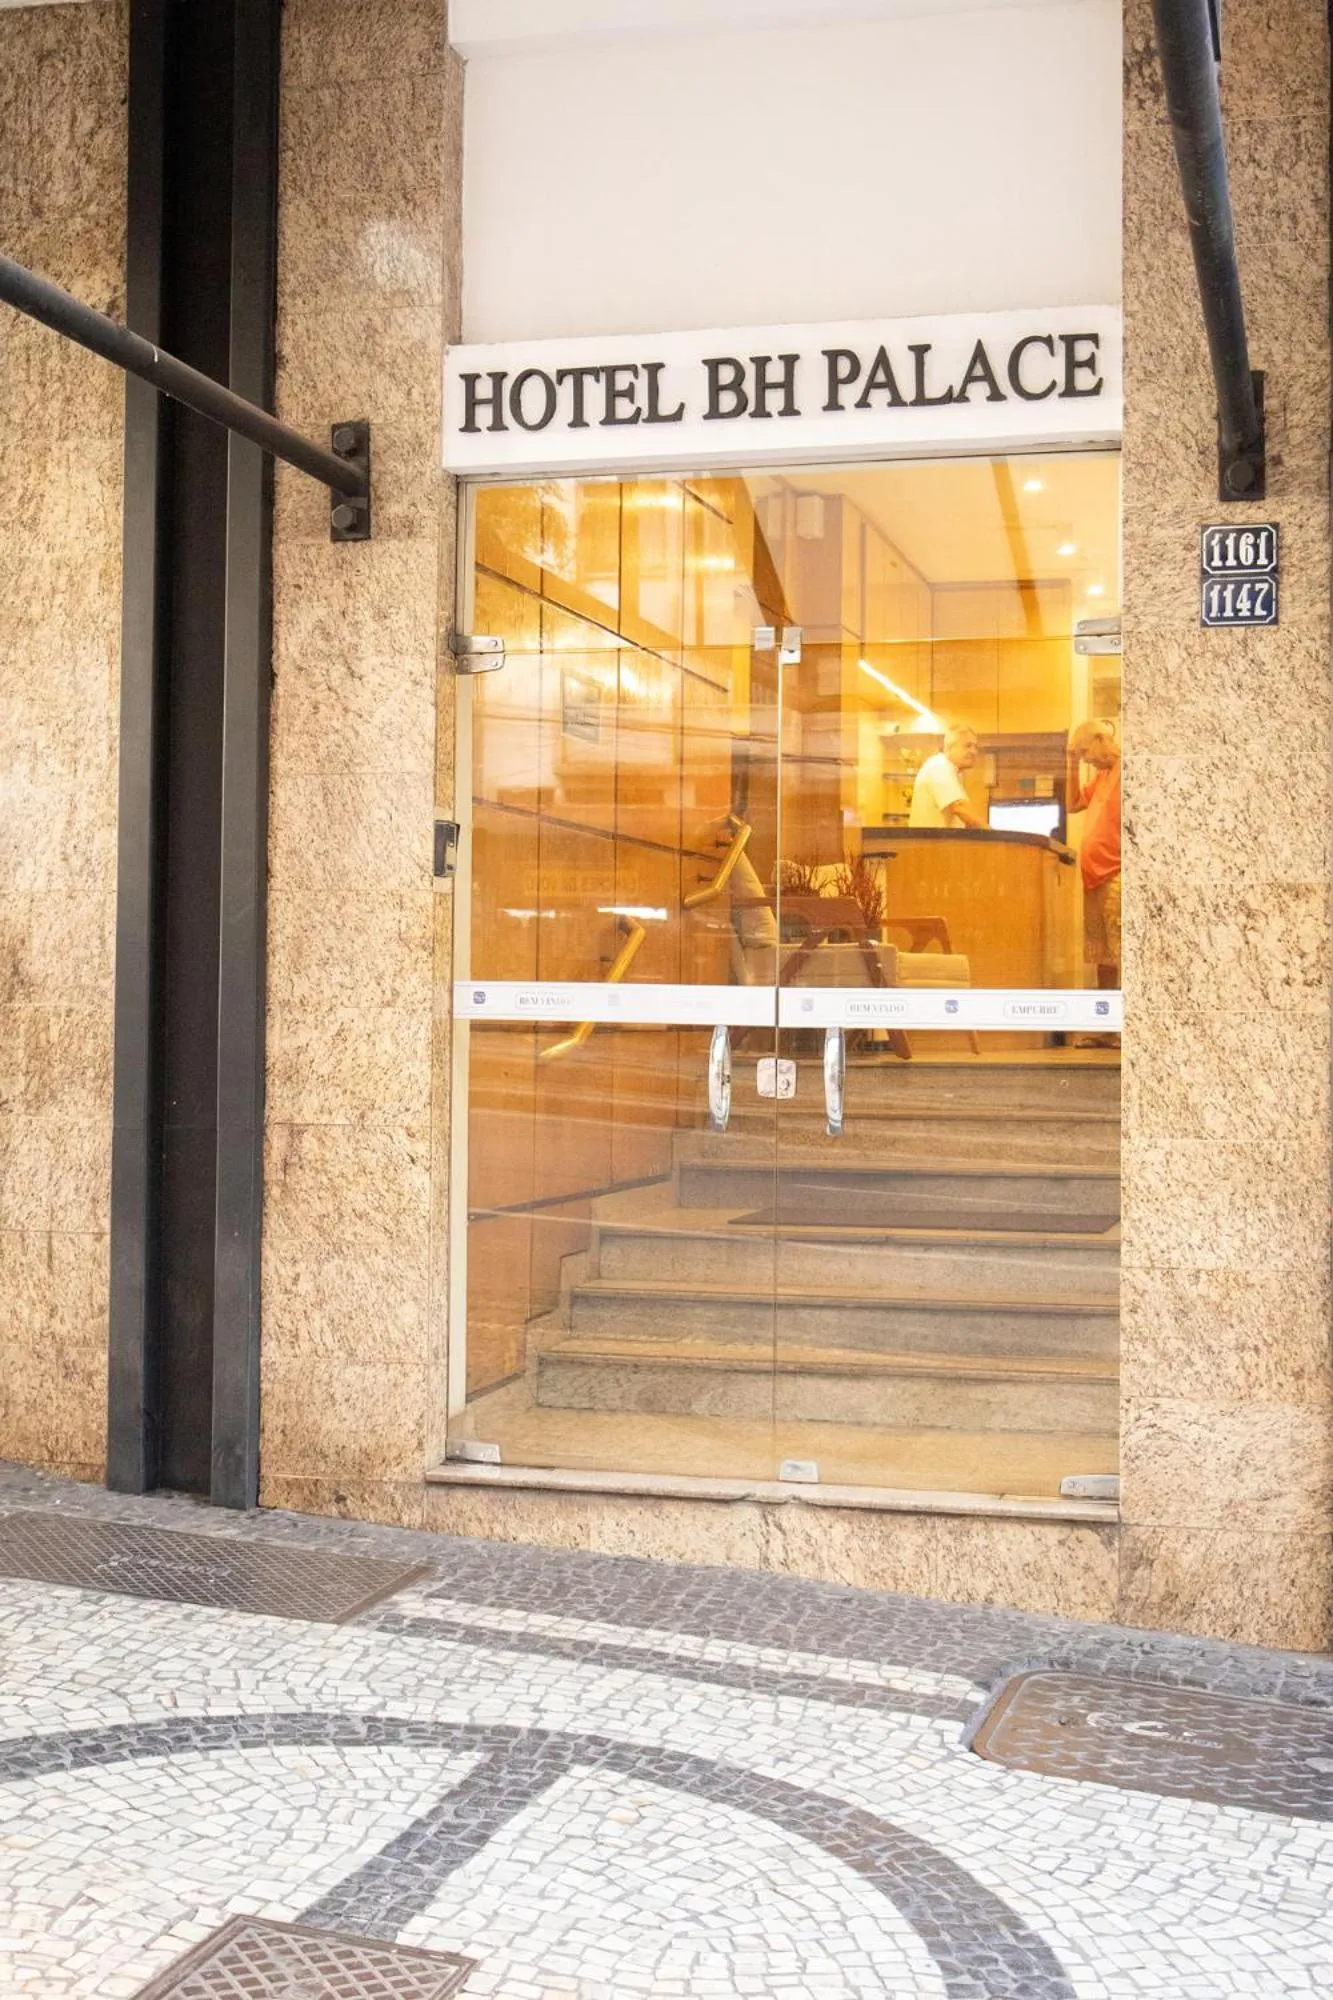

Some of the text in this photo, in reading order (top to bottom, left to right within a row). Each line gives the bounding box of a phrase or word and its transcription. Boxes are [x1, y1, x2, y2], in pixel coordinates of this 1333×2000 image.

[458, 333, 1103, 433] HOTEL BH PALACE
[1211, 531, 1268, 567] 1161
[1209, 583, 1269, 617] 1147
